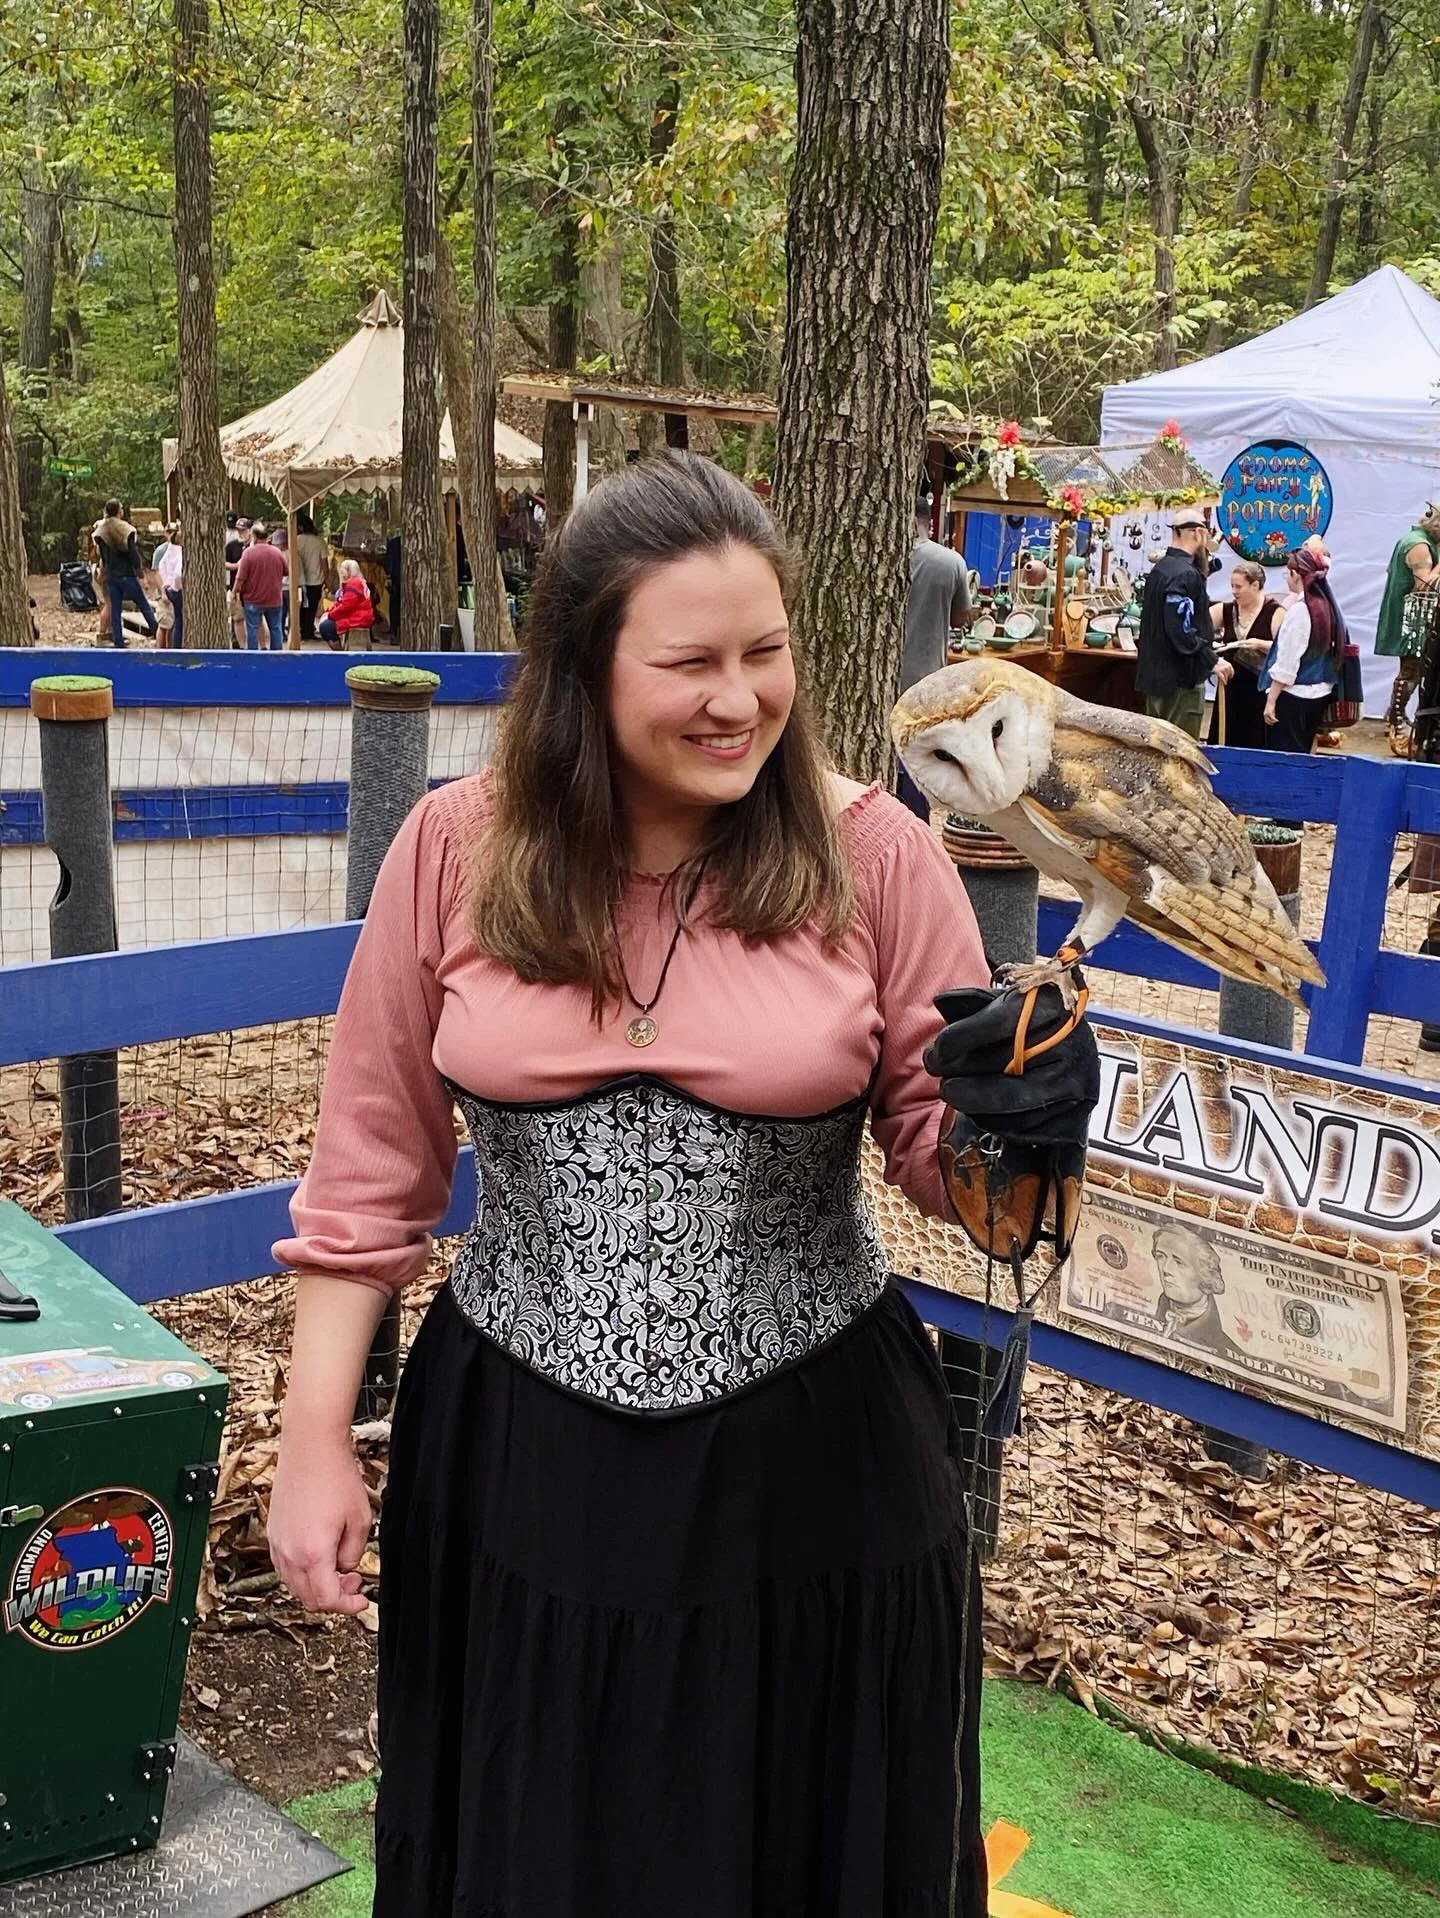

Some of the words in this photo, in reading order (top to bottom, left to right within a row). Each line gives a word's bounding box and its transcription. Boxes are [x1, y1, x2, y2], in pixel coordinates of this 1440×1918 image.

[1234, 474, 1300, 500] Fairy
[1085, 1052, 1440, 1243] LAND
[1215, 1234, 1270, 1255] RESERVE
[1277, 1251, 1310, 1268] NOTE
[1240, 1256, 1267, 1274] THE
[1269, 1264, 1321, 1287] UNITED
[1323, 1279, 1376, 1302] STATES
[1266, 1277, 1284, 1290] OF
[1285, 1281, 1354, 1309] AMERICA
[1343, 1267, 1382, 1292] 10
[1123, 1310, 1166, 1332] TEN
[1225, 1348, 1326, 1391] DOLLARS
[148, 1512, 168, 1562] CENTER
[16, 1528, 53, 1591] COMMAND
[9, 1565, 169, 1625] WILDLIFE
[29, 1619, 50, 1639] We
[50, 1632, 79, 1645] Can
[82, 1615, 125, 1642] Catch
